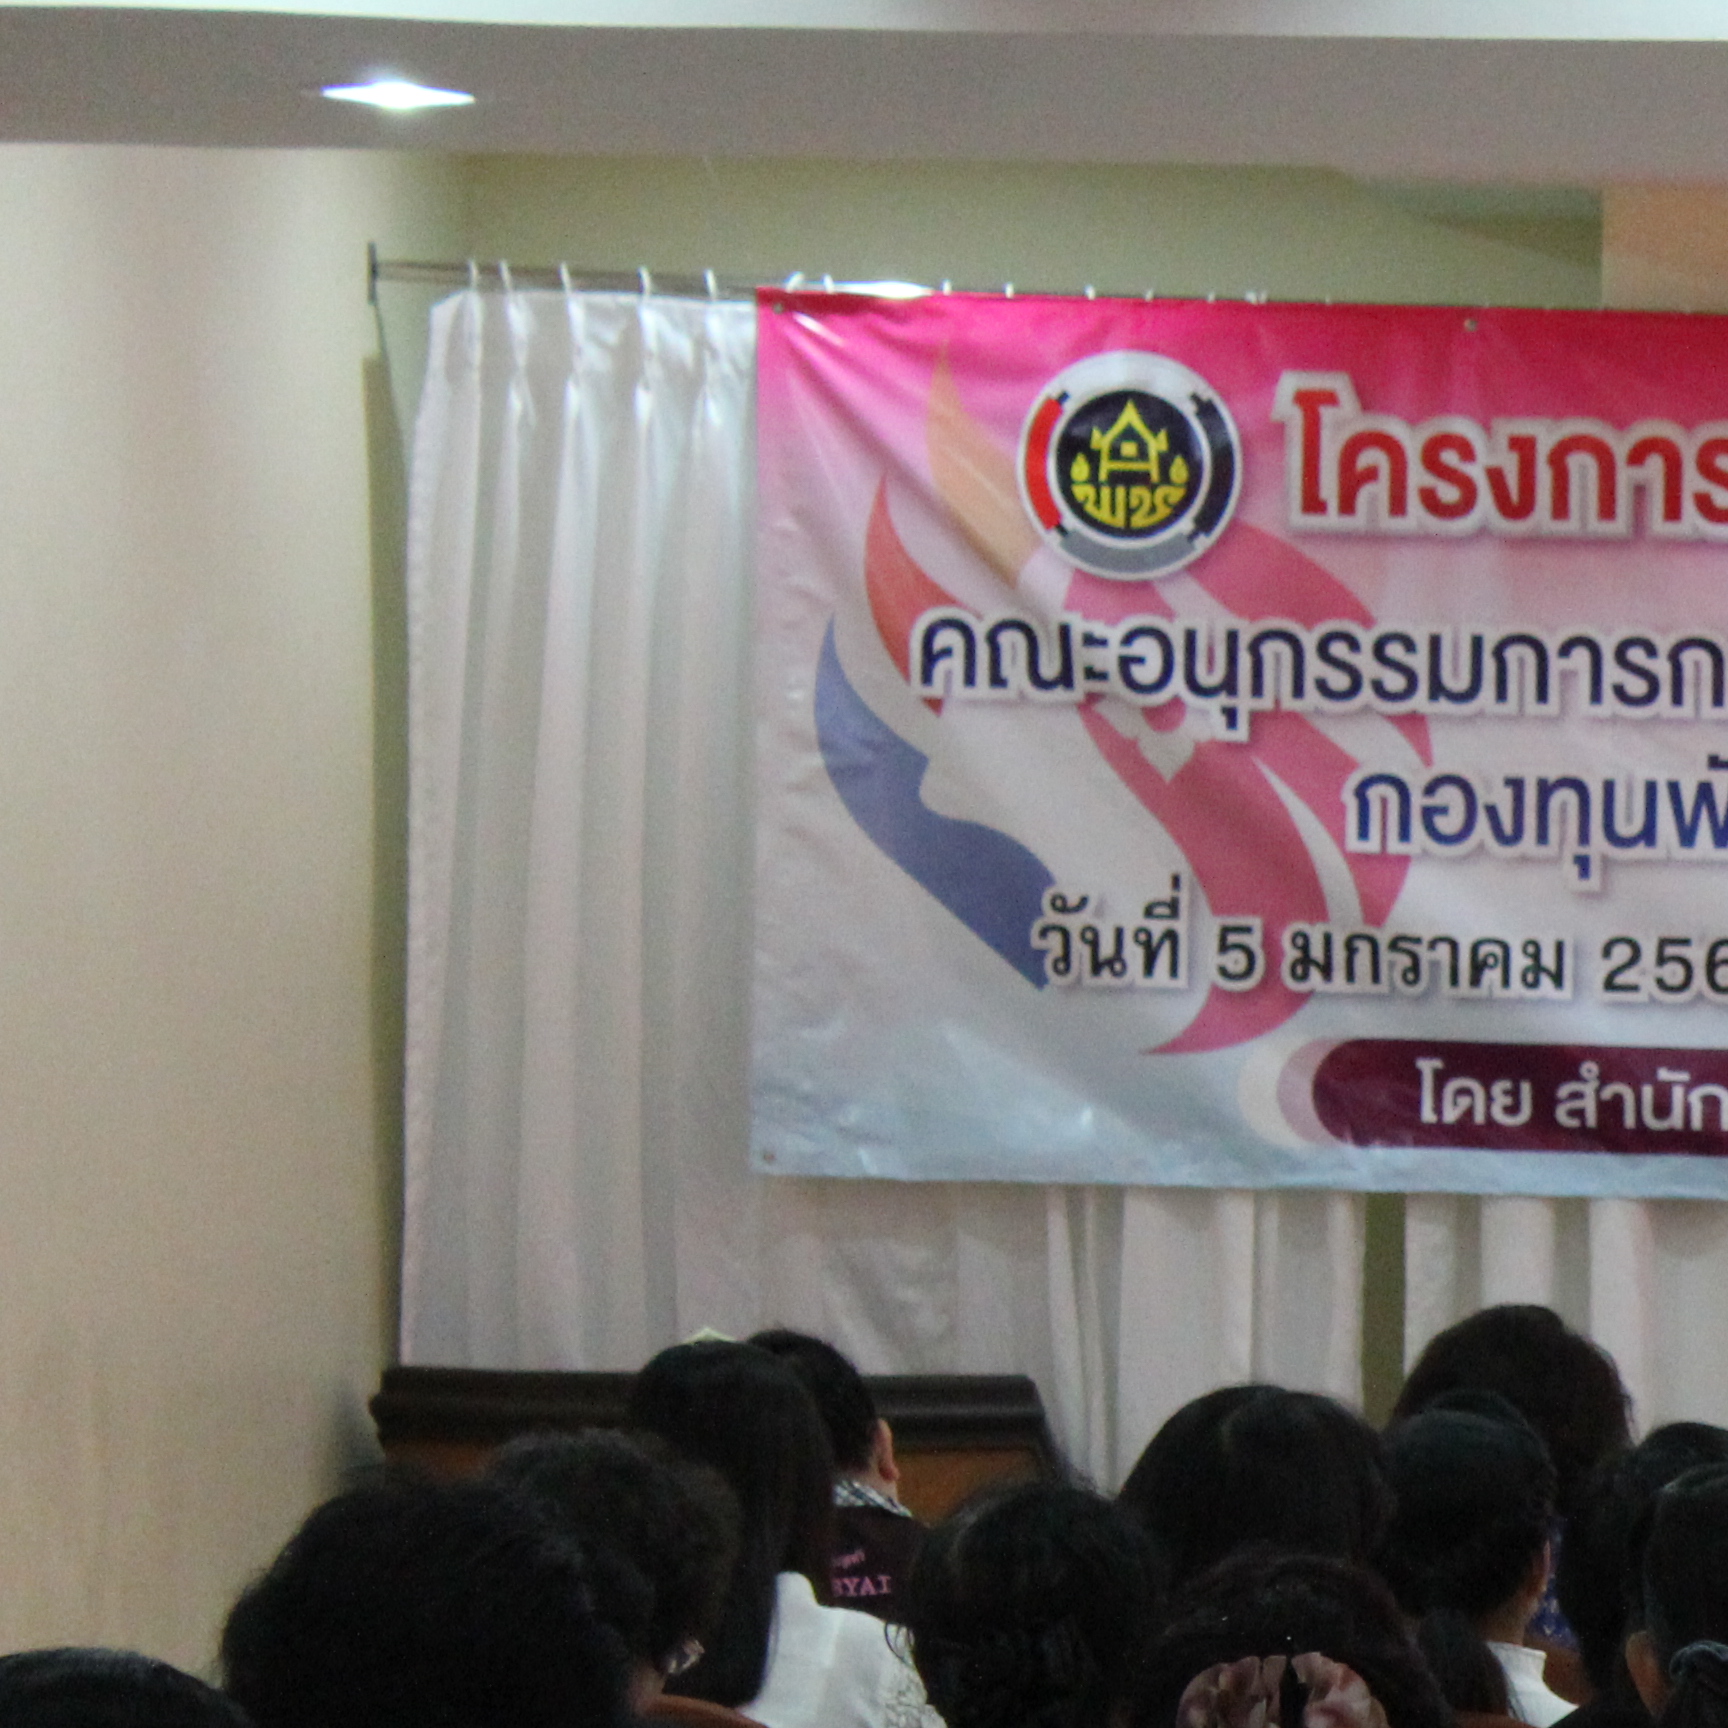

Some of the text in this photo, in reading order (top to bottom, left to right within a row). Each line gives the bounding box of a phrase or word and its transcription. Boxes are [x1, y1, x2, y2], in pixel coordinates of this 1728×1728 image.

[1038, 873, 1182, 980] วันที่
[1216, 924, 1257, 982] 5
[1289, 930, 1566, 991] มกราคม
[1416, 1058, 1533, 1128] โดย
